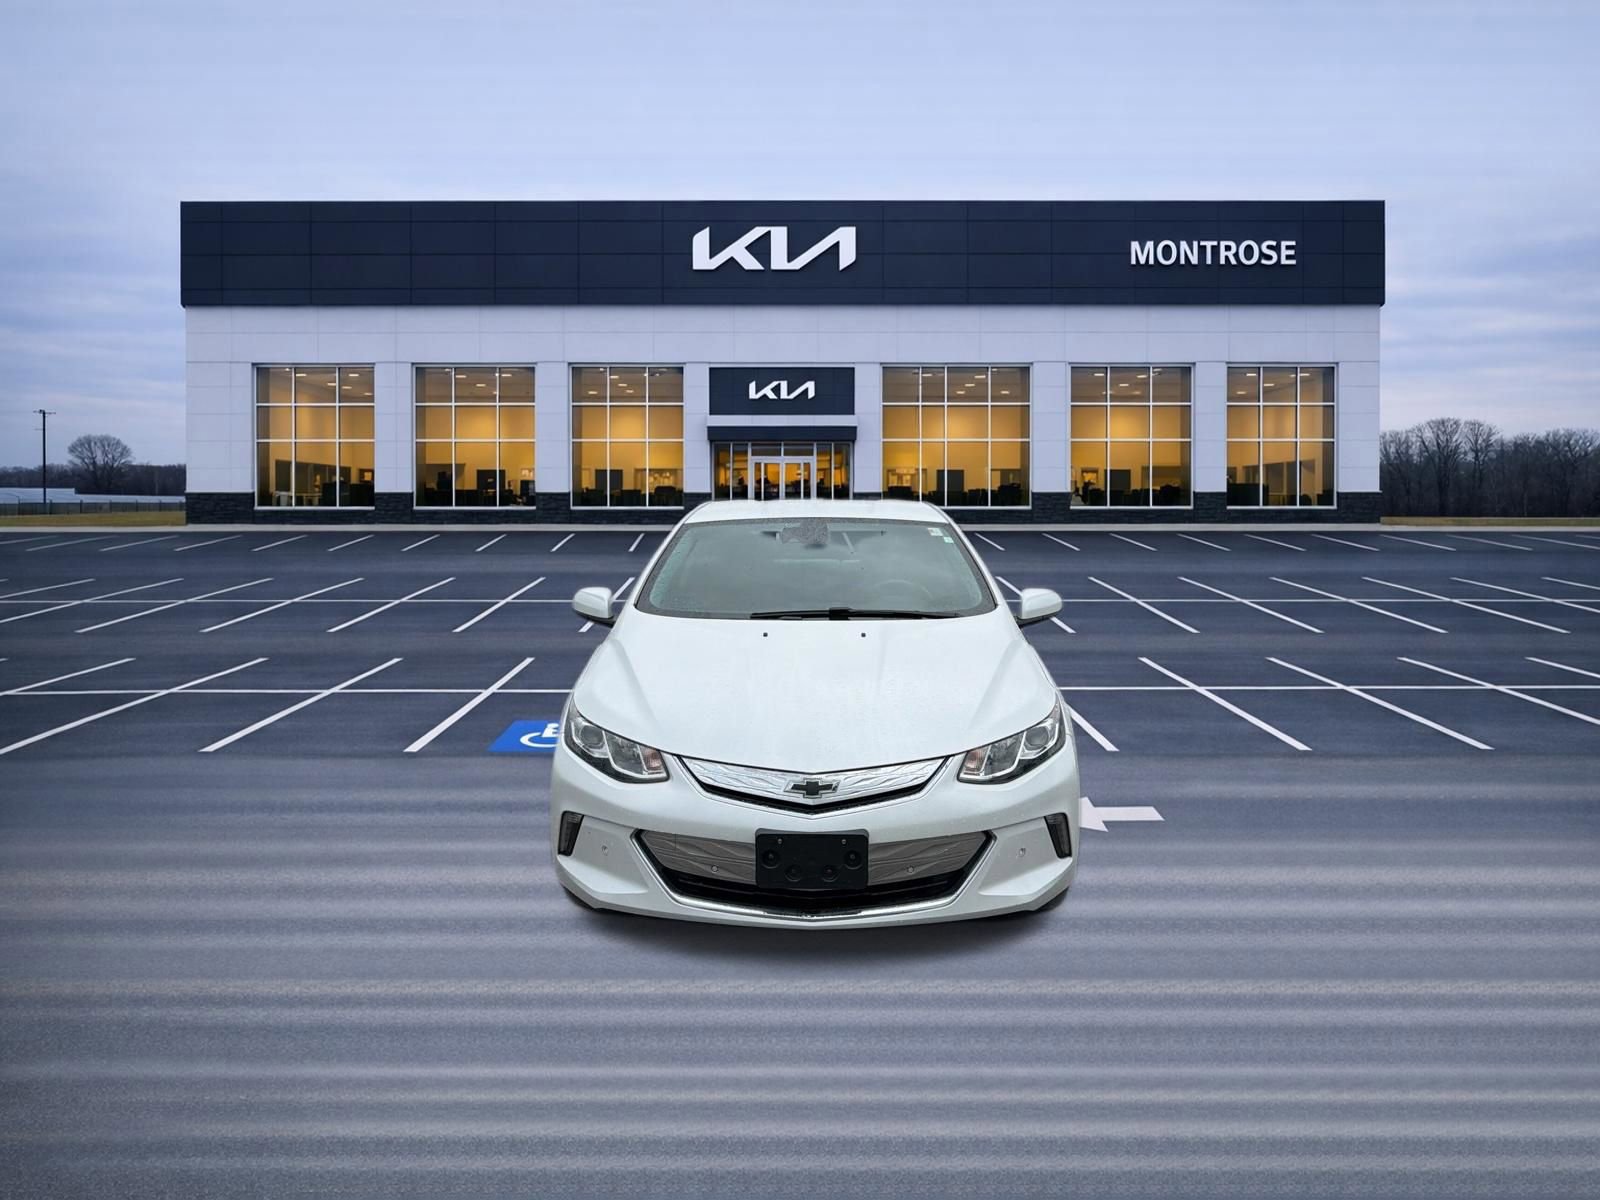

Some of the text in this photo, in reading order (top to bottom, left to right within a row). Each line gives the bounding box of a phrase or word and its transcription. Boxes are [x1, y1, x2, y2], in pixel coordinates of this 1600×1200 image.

[692, 226, 857, 271] KIA
[1130, 239, 1297, 266] MONTROSE
[748, 380, 816, 400] KIA
